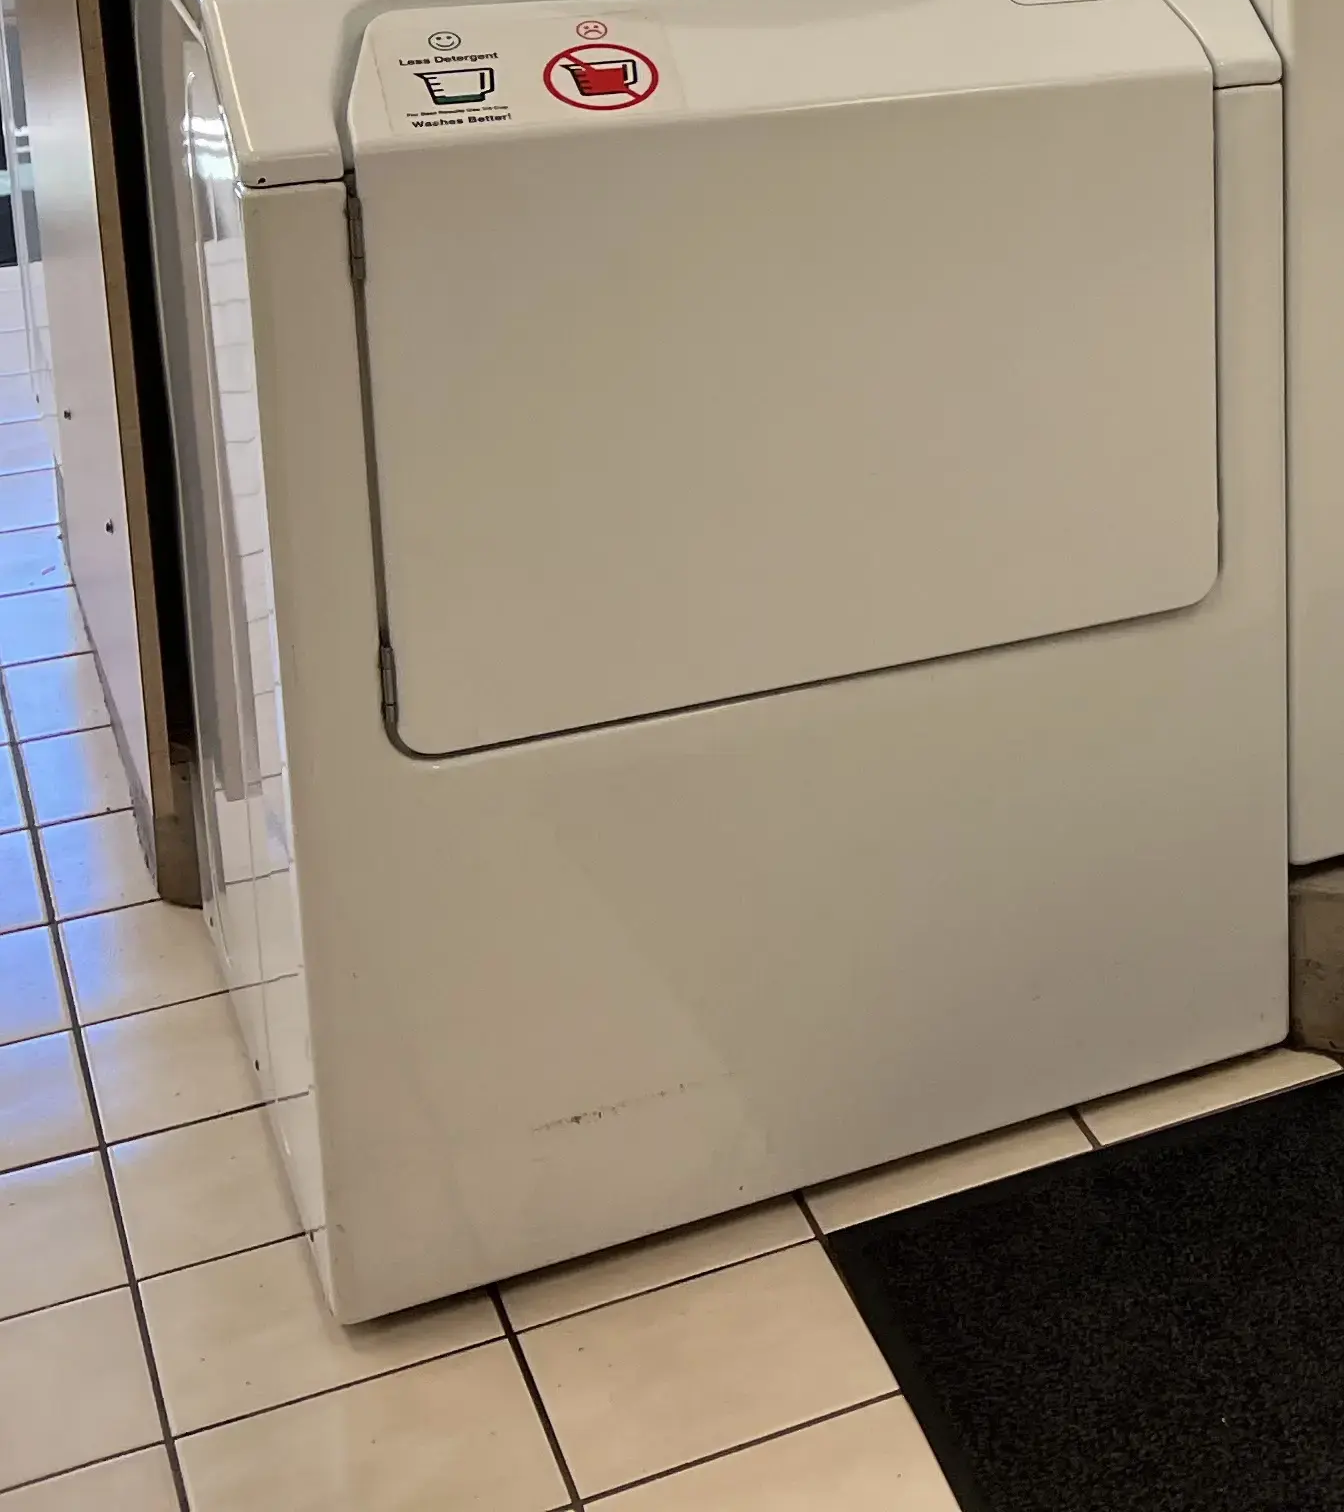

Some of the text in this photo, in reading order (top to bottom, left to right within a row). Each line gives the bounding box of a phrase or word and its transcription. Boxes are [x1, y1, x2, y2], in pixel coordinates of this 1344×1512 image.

[399, 51, 498, 66] Less Detergent
[412, 113, 512, 128] Washes Better!
